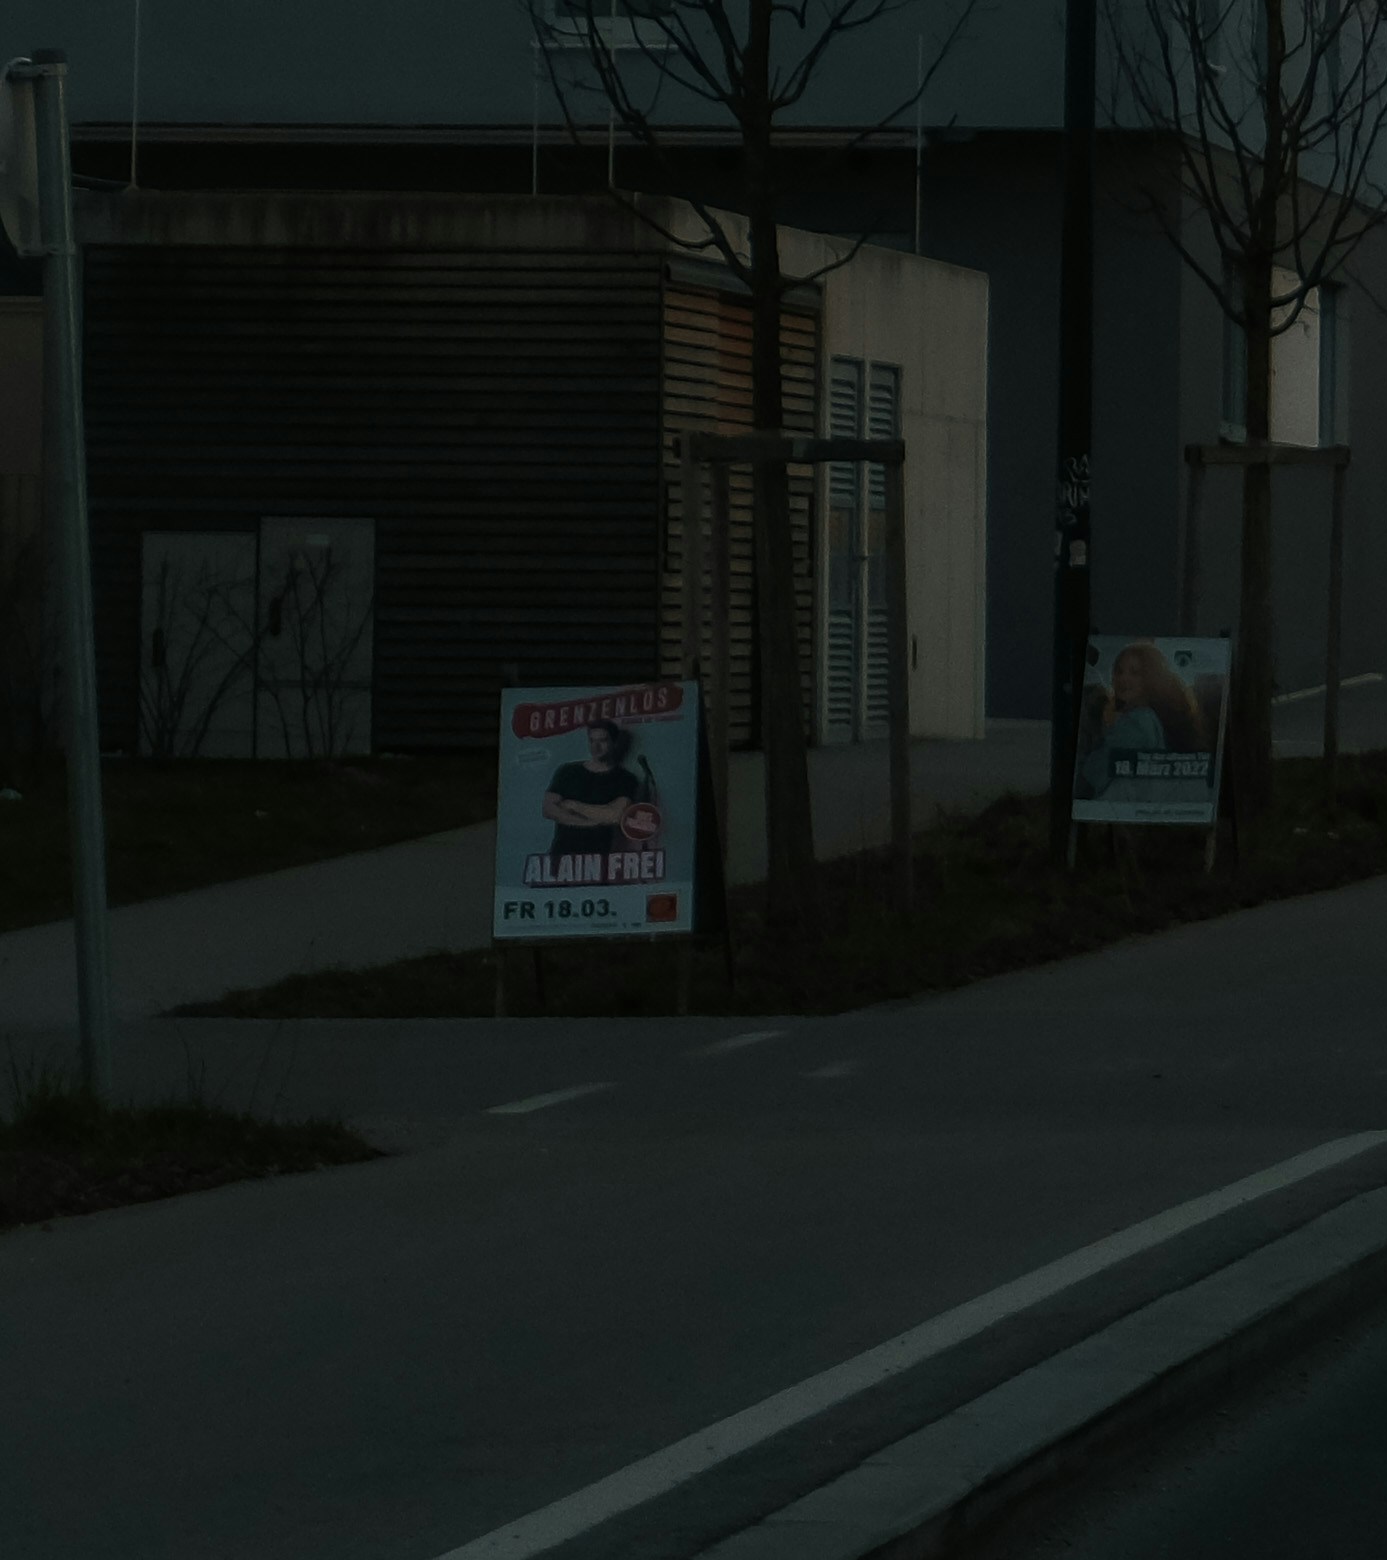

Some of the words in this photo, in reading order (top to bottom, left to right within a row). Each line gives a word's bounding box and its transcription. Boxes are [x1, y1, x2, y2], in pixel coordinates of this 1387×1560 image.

[529, 687, 668, 732] GRENZENLOS
[525, 853, 602, 883] ALAIN
[607, 850, 664, 880] FREI
[504, 900, 535, 920] FR
[544, 898, 617, 918] 18.03.
